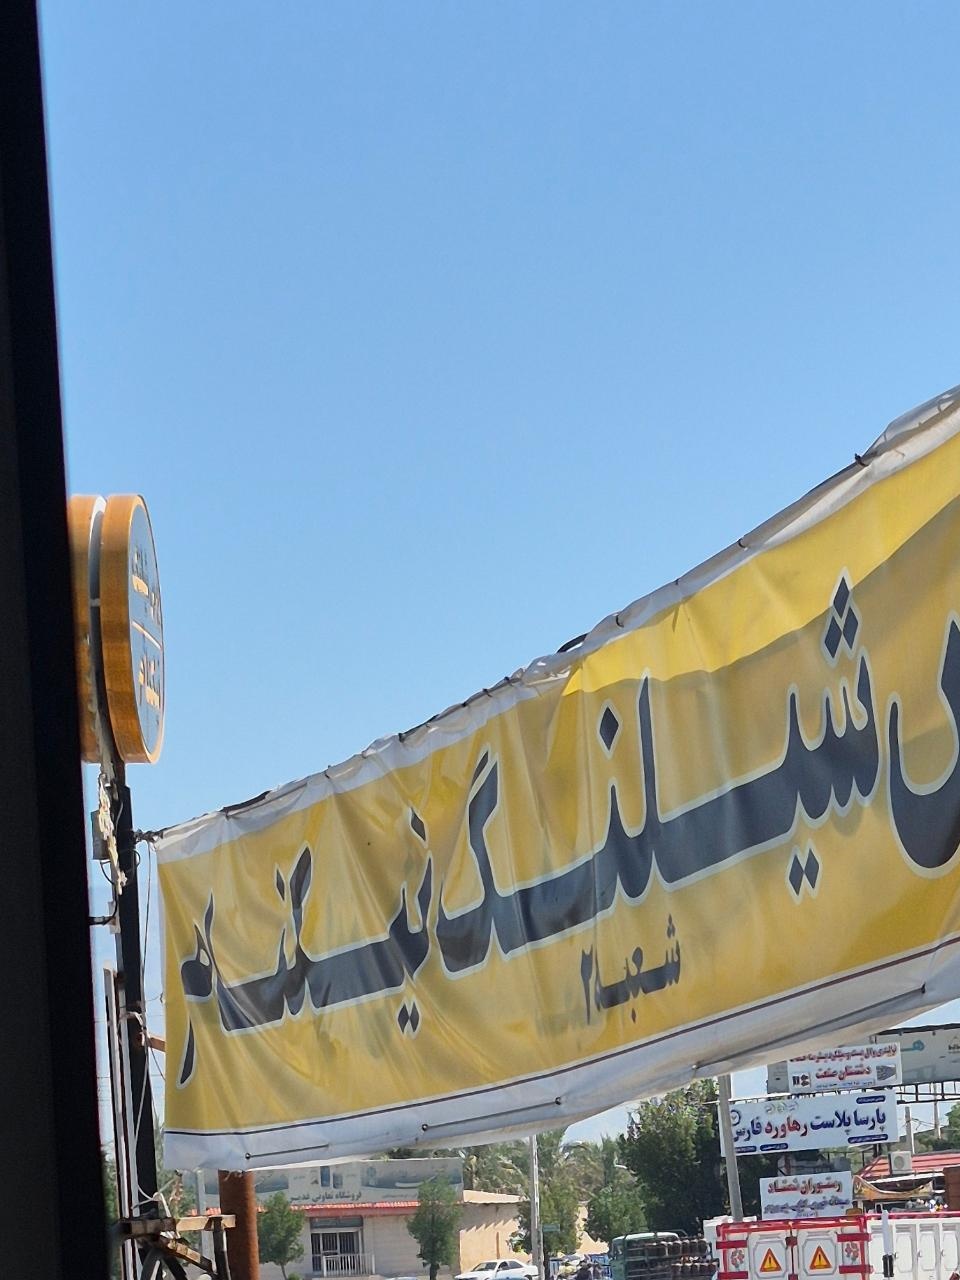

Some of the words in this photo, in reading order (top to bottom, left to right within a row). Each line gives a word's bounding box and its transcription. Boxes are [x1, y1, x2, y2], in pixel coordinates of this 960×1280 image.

[436, 575, 880, 973] شیلنگ
[180, 807, 432, 1085] نیکنام
[595, 913, 681, 1024] شعبه
[810, 1109, 852, 1135] پلاست
[853, 1107, 886, 1132] پارسا
[312, 1191, 336, 1203] تعاونی
[335, 1191, 363, 1201] فروشگاه
[800, 1176, 843, 1195] رستوران
